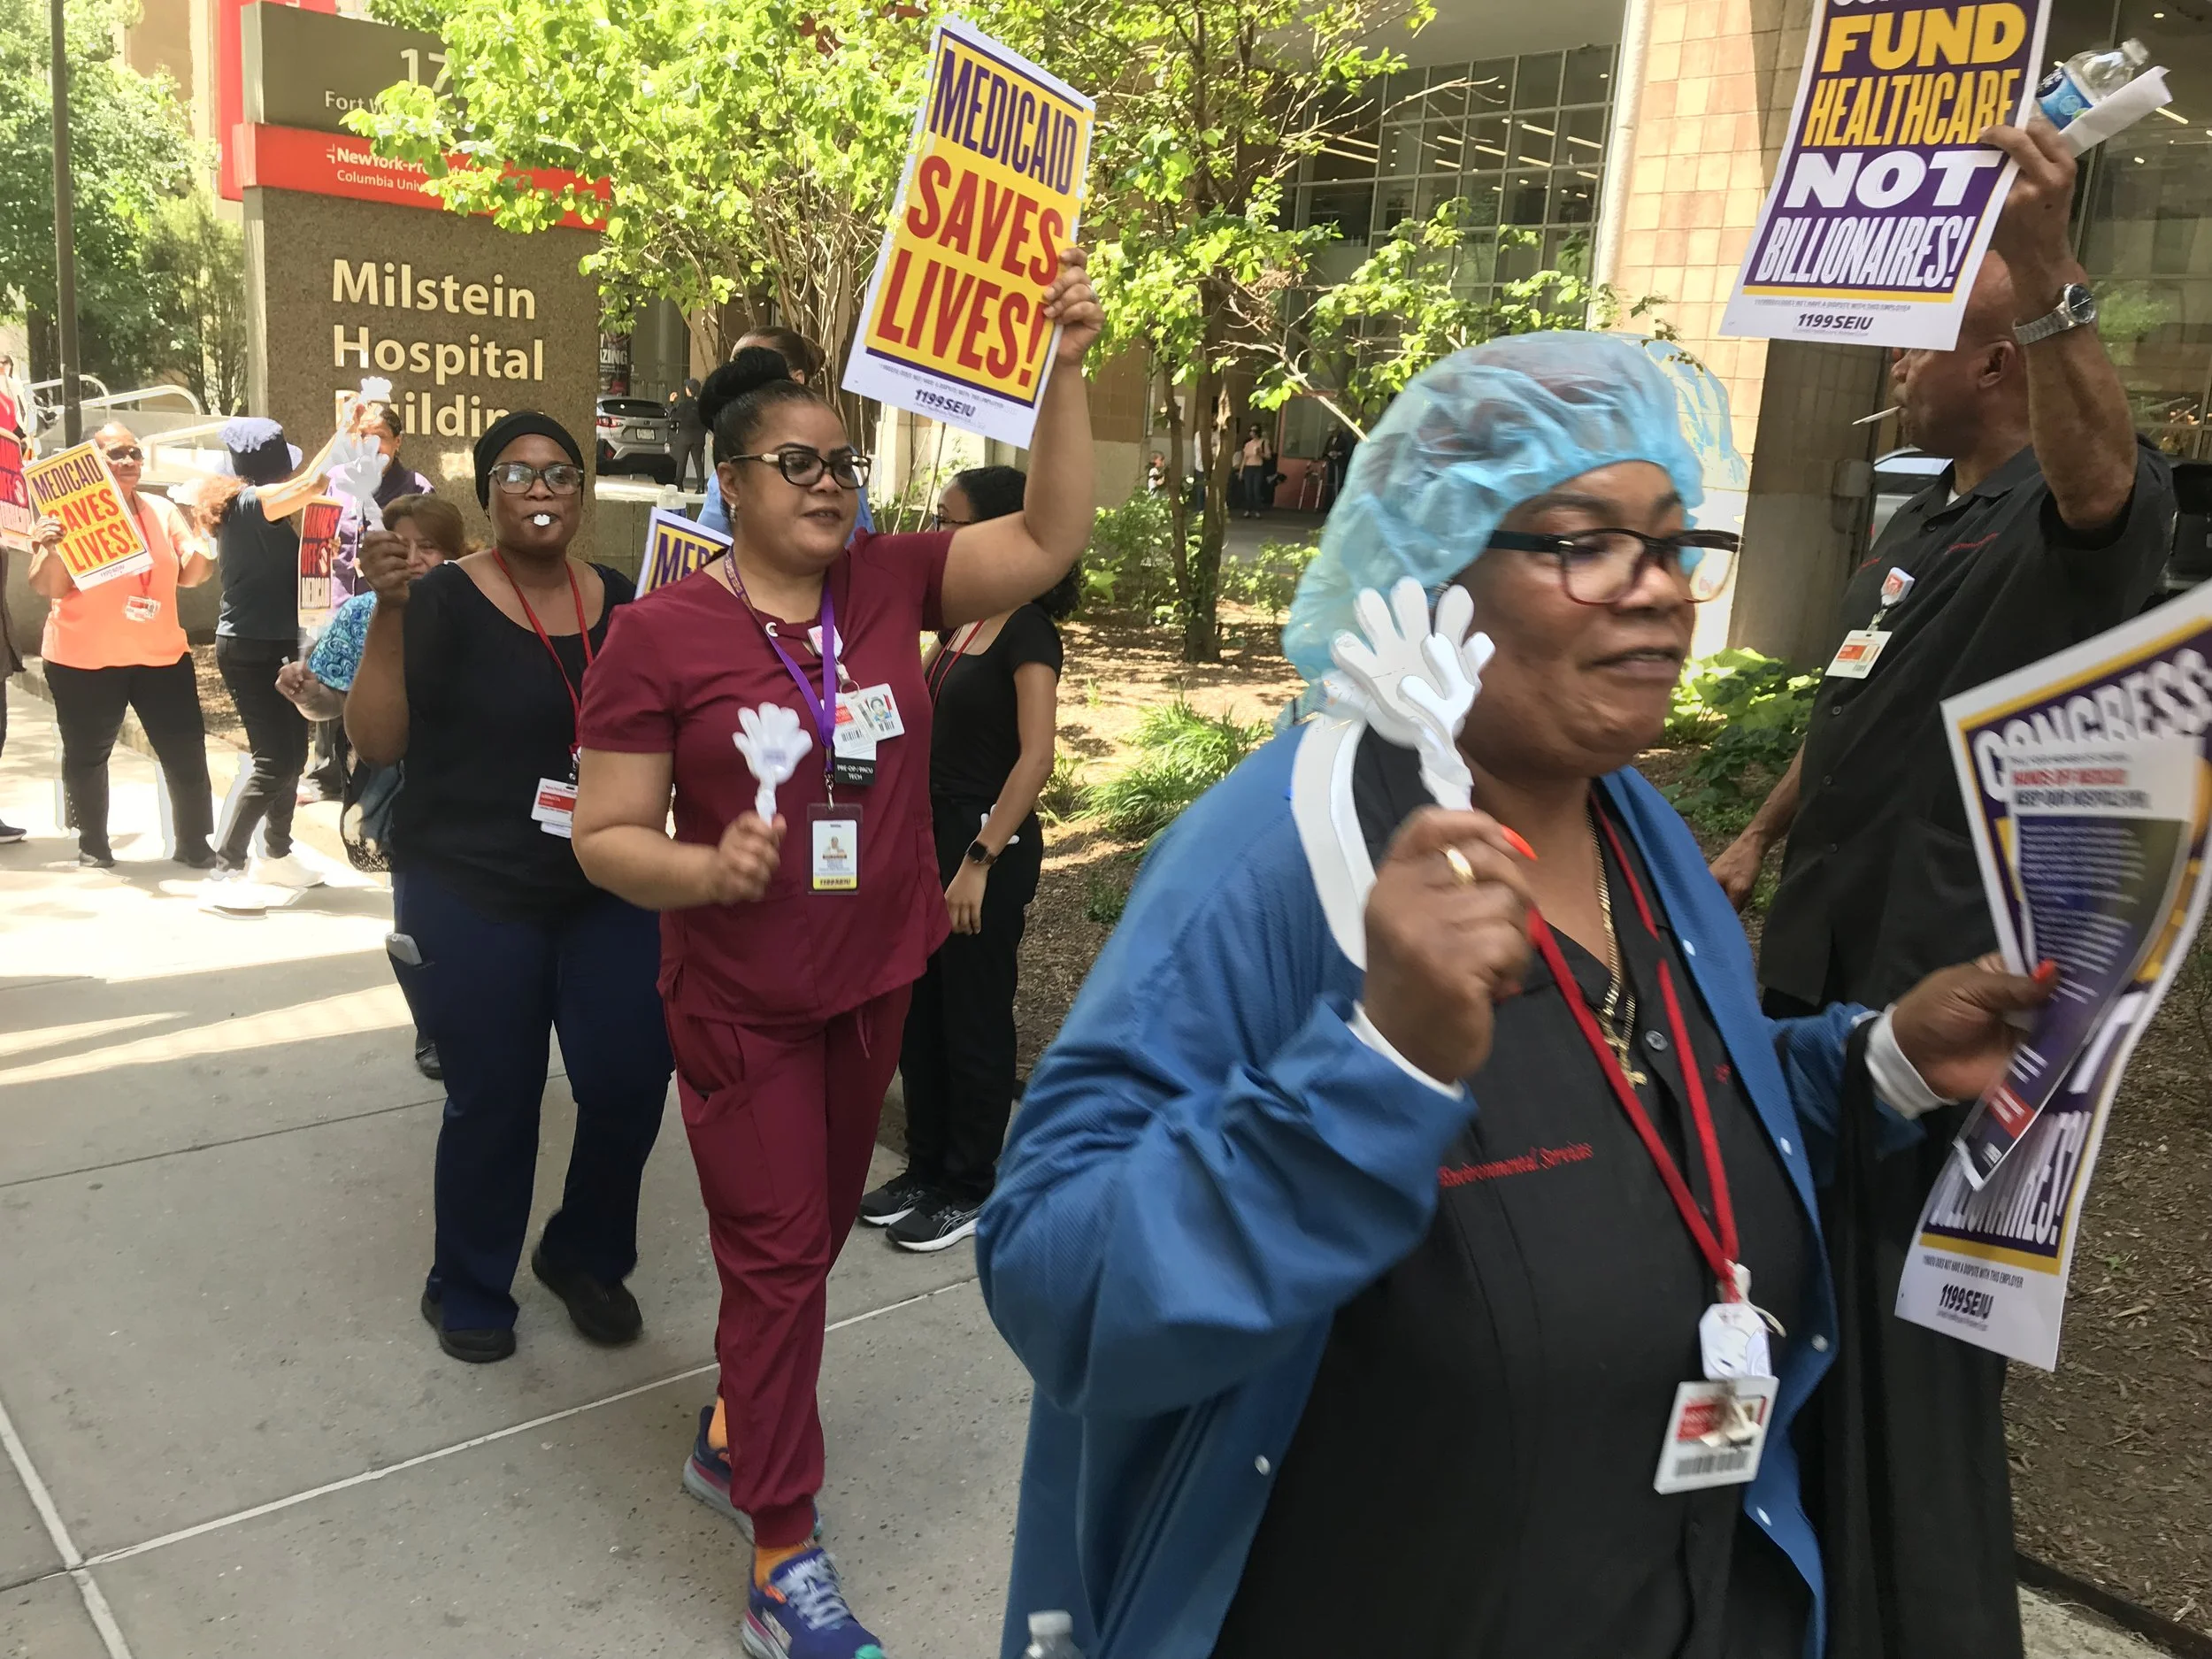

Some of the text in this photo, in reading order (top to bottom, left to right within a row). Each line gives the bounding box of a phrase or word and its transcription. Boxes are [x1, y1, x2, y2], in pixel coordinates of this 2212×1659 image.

[1821, 3, 2027, 73] FUND
[325, 90, 365, 111] Fort
[930, 50, 1078, 196] MEDICAID
[1801, 68, 2021, 147] HEALTHCARE
[336, 170, 394, 188] Columbia
[1783, 150, 2004, 209] NOT
[907, 155, 1064, 287] SAVES
[1755, 215, 1977, 288] BILLIONAIRES!
[333, 258, 535, 319] Milstein
[876, 249, 1048, 388] LIVES!
[1797, 313, 1874, 331] 1199SEIU
[334, 324, 543, 386] Hospital
[915, 388, 976, 417] 1199SEIU
[32, 453, 104, 505] MEDICAID
[64, 519, 139, 573] LIVES!
[1939, 1283, 1994, 1320] 1199SEIU
